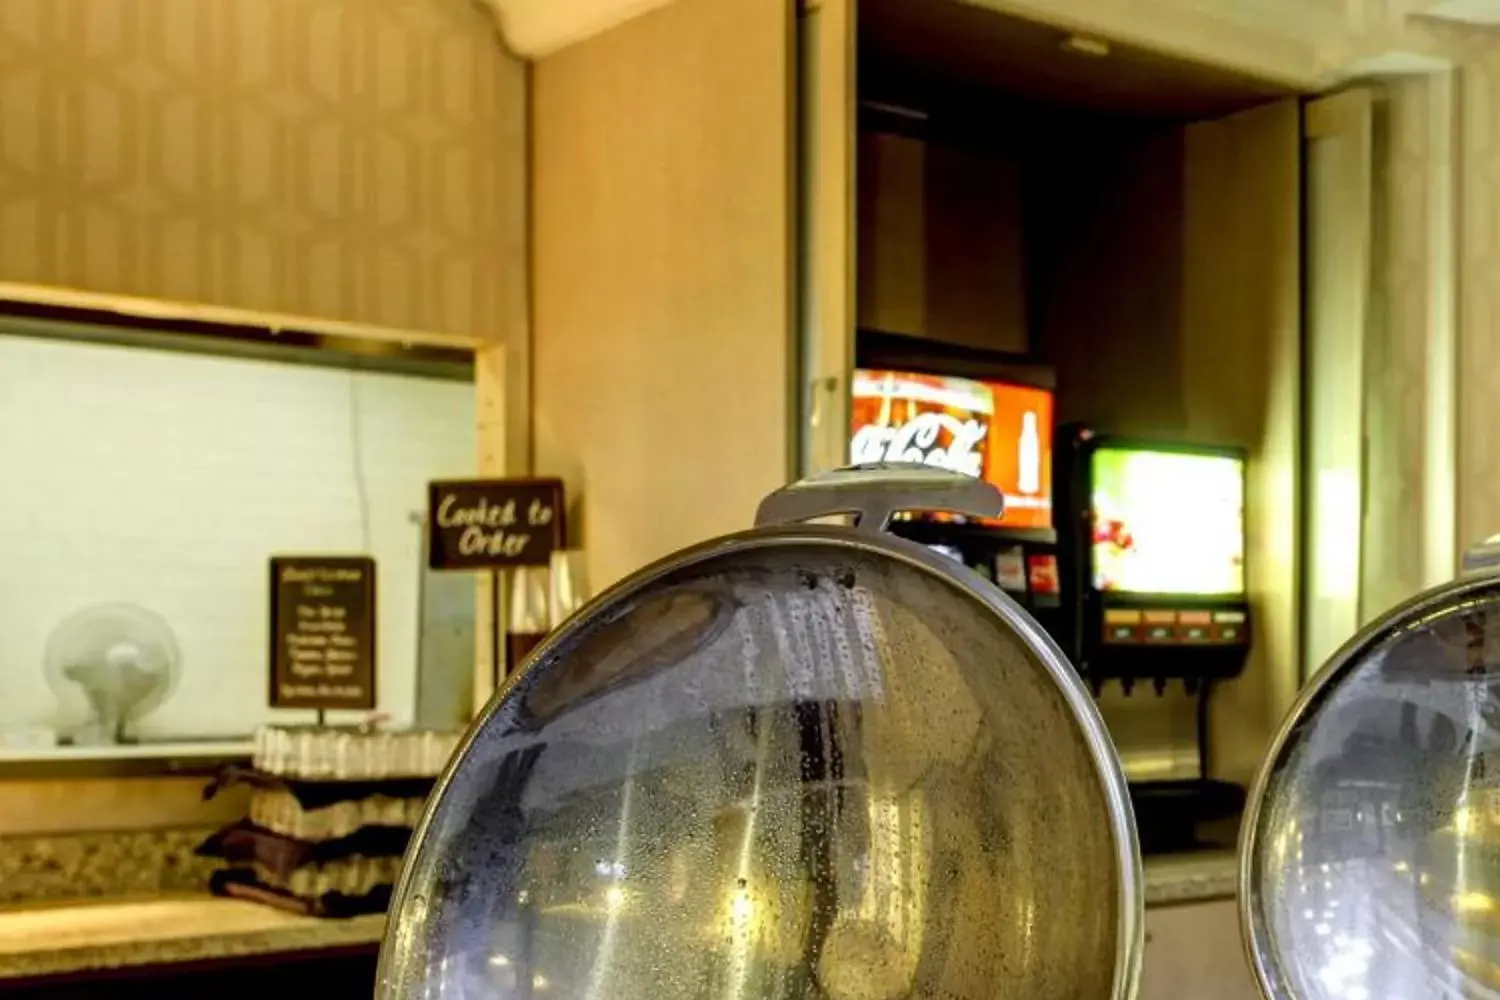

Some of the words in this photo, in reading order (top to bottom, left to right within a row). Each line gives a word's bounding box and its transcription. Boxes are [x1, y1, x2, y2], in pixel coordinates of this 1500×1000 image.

[437, 493, 517, 528] Cooked
[527, 497, 553, 525] to
[458, 526, 532, 556] Order
